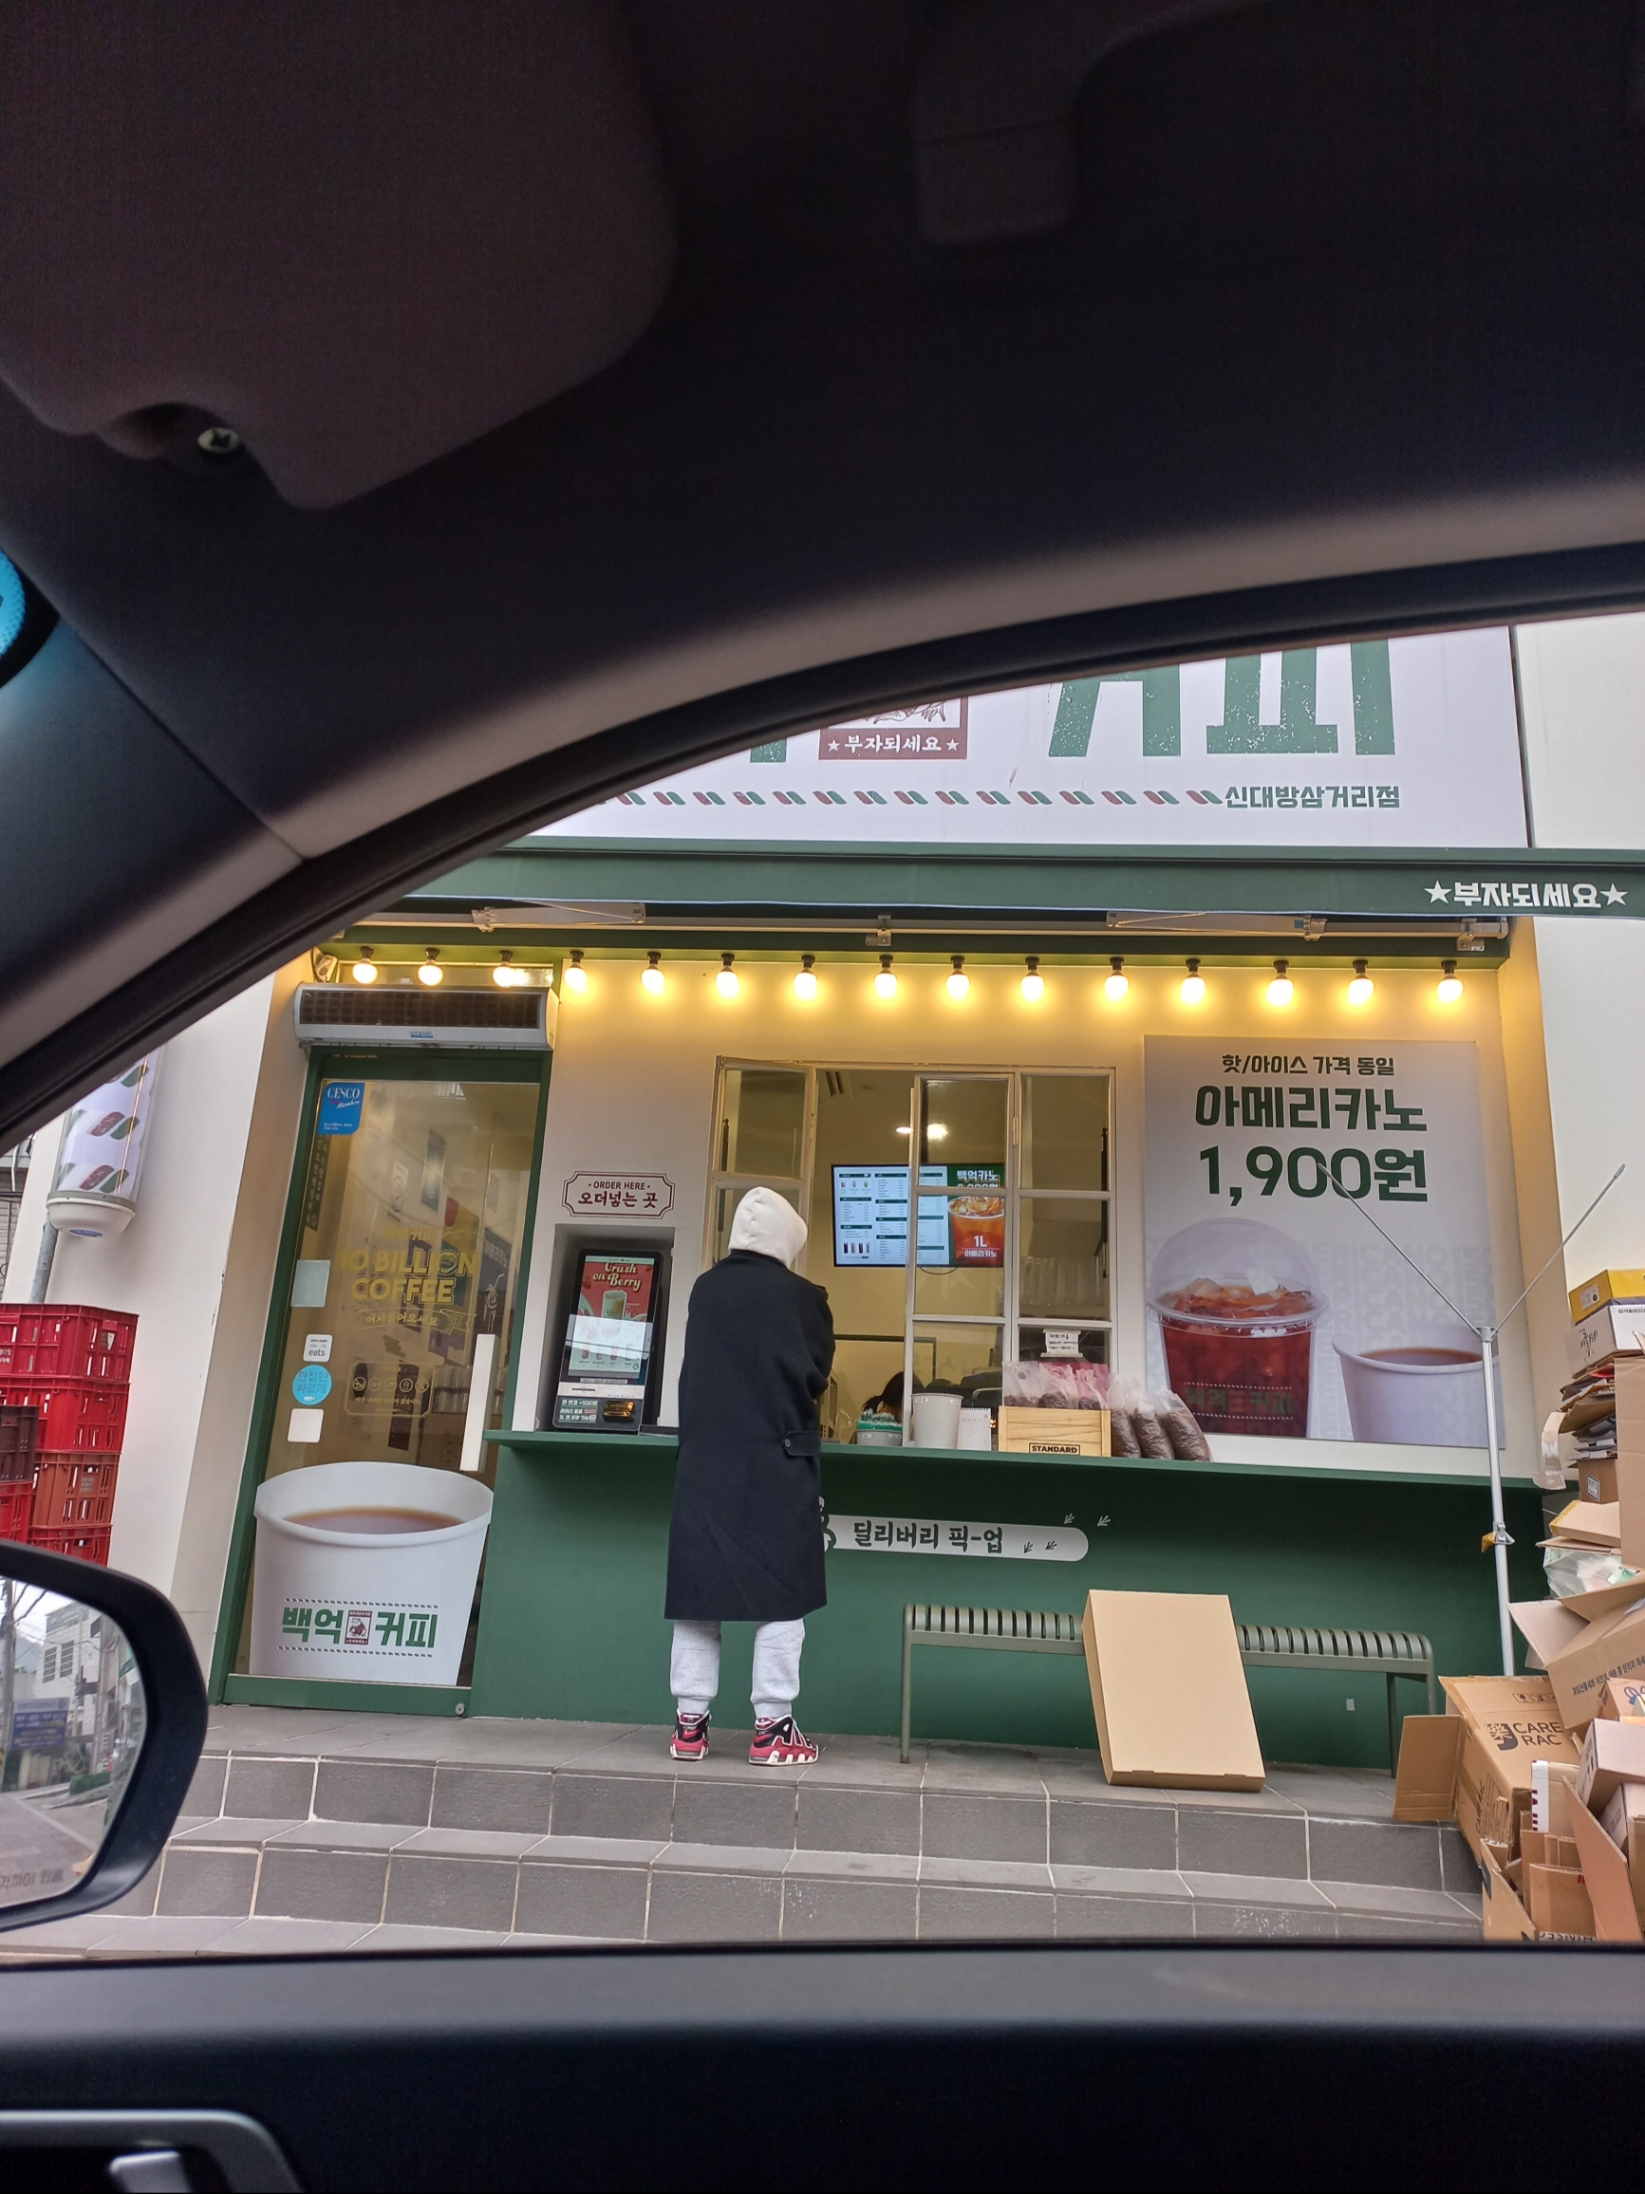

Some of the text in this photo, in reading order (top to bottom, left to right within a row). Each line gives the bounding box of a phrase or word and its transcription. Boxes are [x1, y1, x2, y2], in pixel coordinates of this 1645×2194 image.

[844, 733, 942, 754] 부자되세요
[1224, 785, 1400, 809] 신대방삼거리점
[1453, 882, 1602, 908] 부자되세요
[1221, 1053, 1395, 1077] 핫/아이스 가격 동일
[327, 1087, 360, 1099] CESCO
[1194, 1085, 1428, 1132] 아메리카노
[956, 1170, 999, 1182] 백억카노
[1199, 1144, 1429, 1207] 1,900원
[593, 1181, 646, 1191] ORDER HERE
[578, 1190, 659, 1209] 오더넣는 곳
[973, 1235, 987, 1247] 1L
[604, 1262, 637, 1274] Crush
[351, 1277, 457, 1304] COFFEE
[592, 1273, 642, 1292] on Berry
[308, 1348, 326, 1357] eats
[1031, 1445, 1078, 1454] STANDARD
[853, 1519, 1004, 1554] 딜리버리 픽-업
[281, 1606, 438, 1649] 백억 커피
[1512, 1721, 1565, 1734] CARE
[1521, 1735, 1563, 1746] RAC
